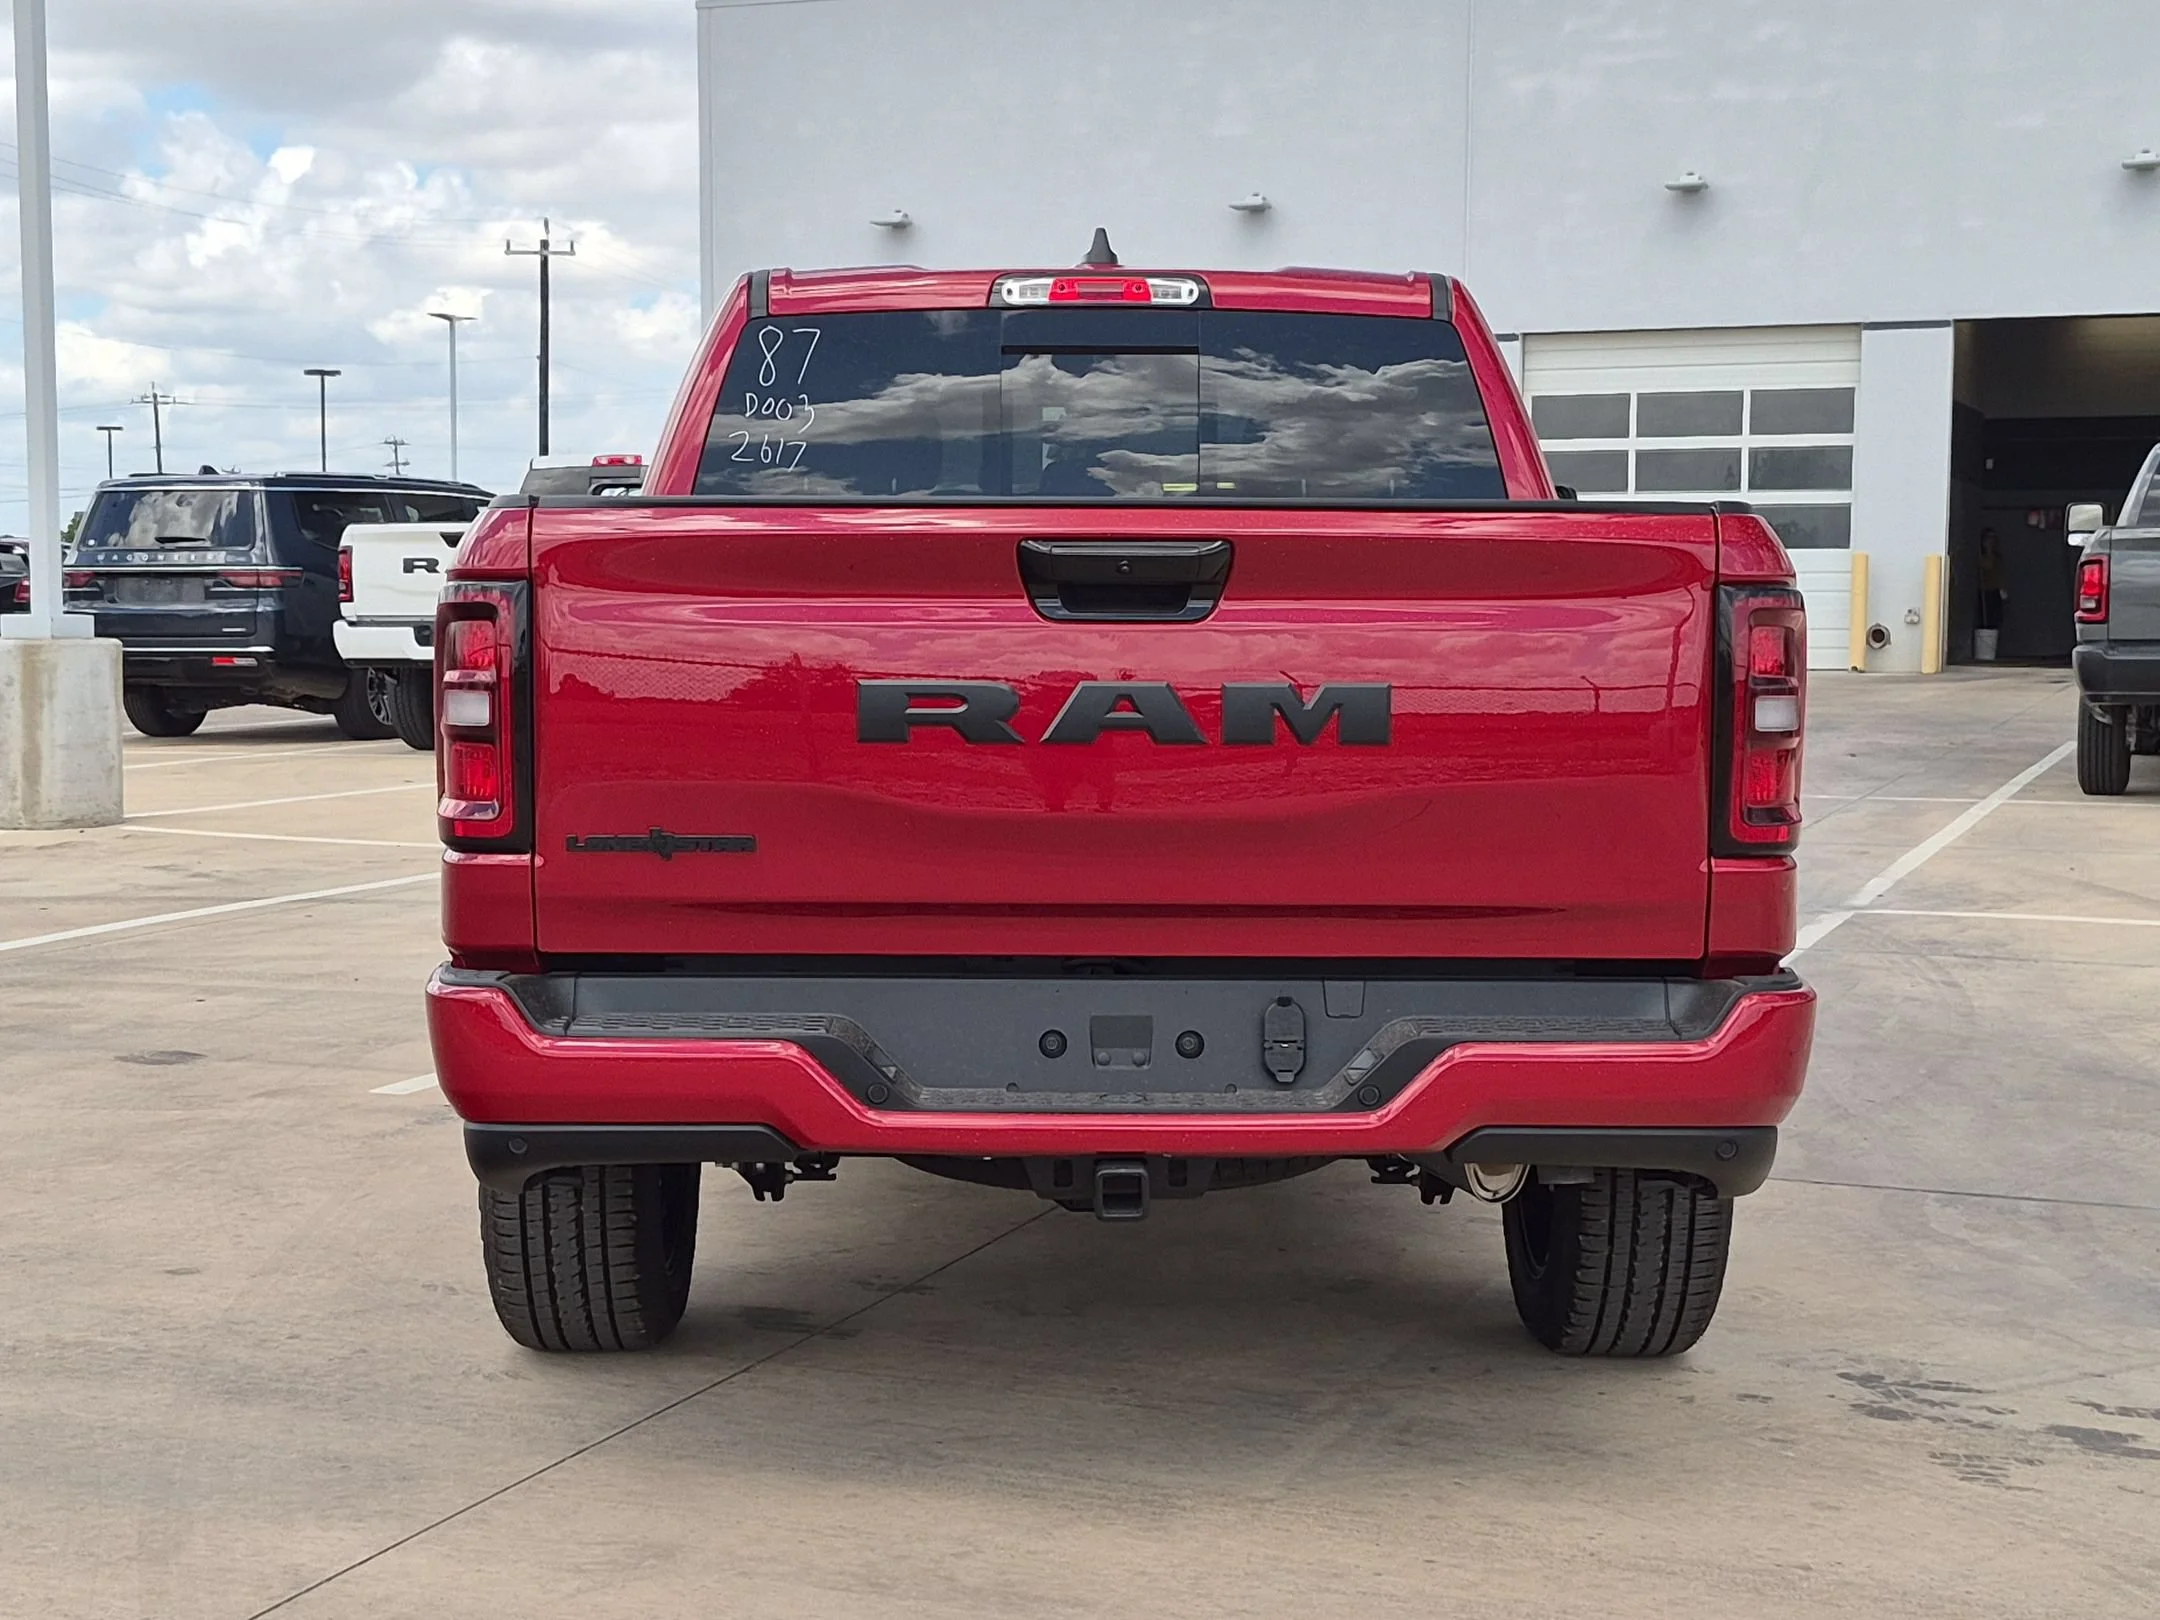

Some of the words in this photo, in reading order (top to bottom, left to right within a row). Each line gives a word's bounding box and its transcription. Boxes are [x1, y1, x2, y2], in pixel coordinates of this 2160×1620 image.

[758, 325, 821, 386] 87
[744, 392, 815, 433] D003
[728, 431, 806, 472] 2617
[856, 679, 1392, 745] RAM
